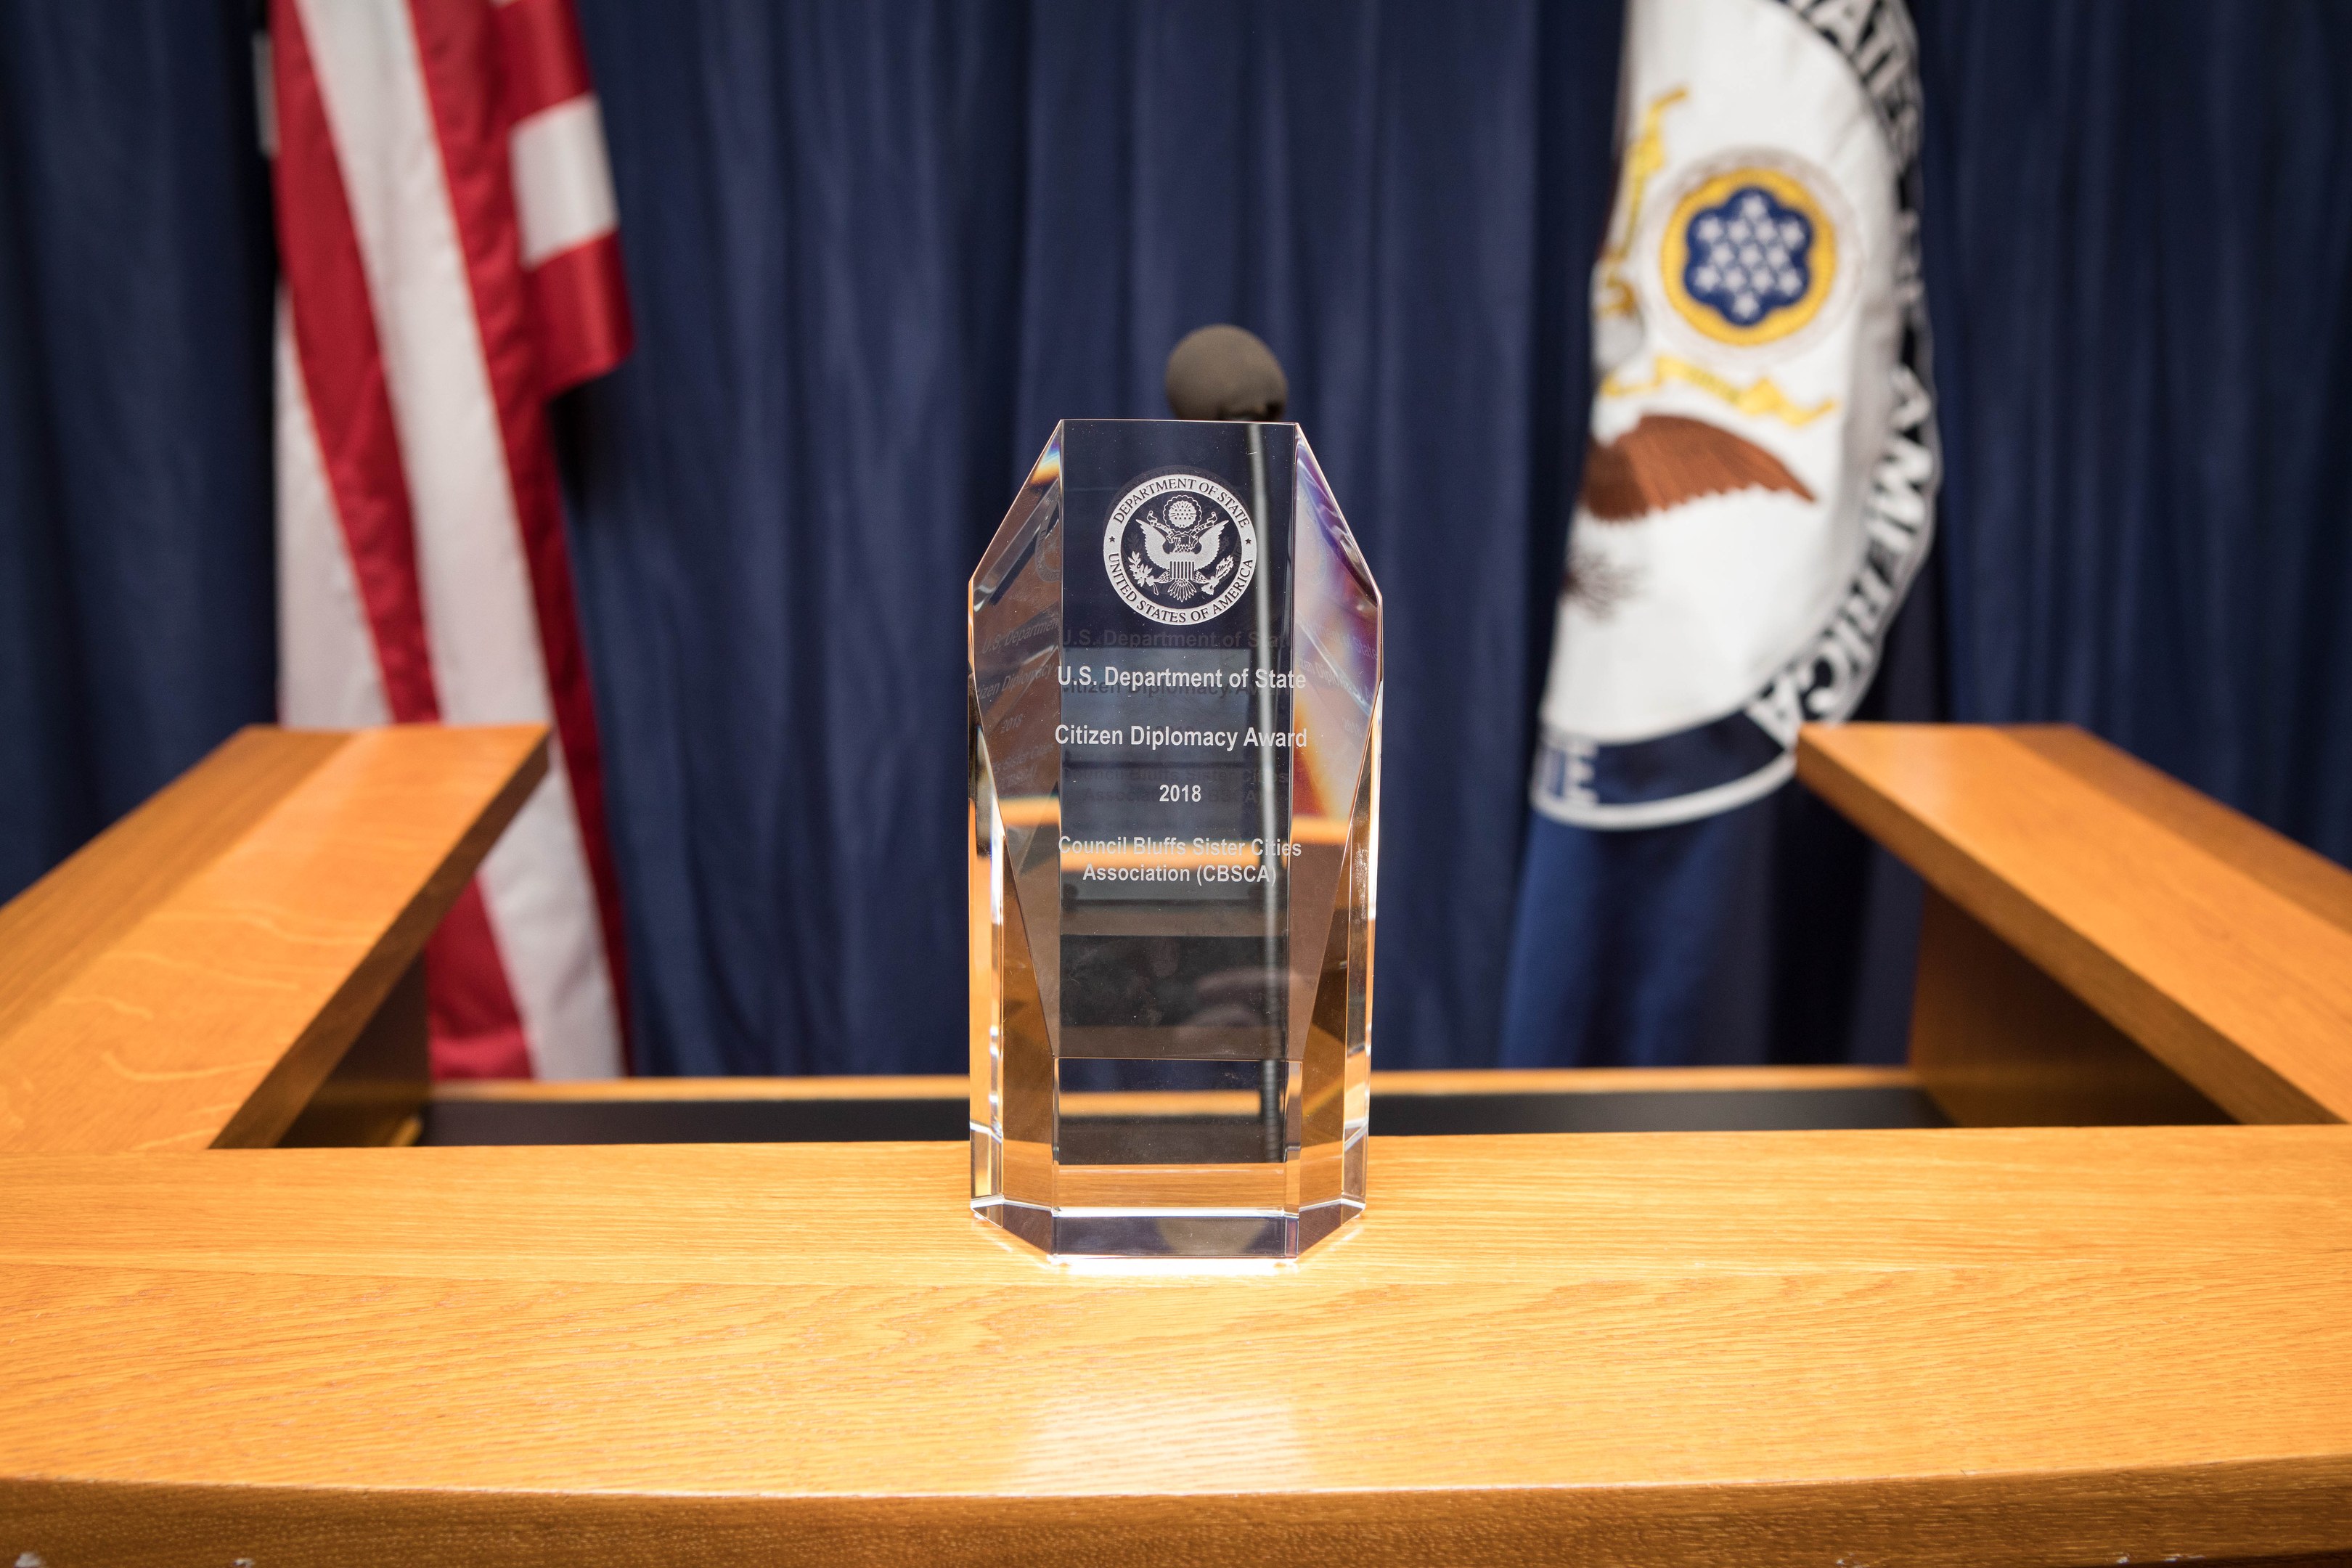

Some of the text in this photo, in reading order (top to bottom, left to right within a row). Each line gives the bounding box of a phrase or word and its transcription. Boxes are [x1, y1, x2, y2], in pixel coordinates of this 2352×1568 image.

[1113, 478, 1250, 528] DEPARTMENT OF STATE
[1108, 553, 1253, 623] UNITED STATES OF AMERICA
[1004, 618, 1060, 646] Departmen
[1058, 666, 1097, 685] U.S.
[1105, 666, 1222, 691] Department
[1229, 668, 1249, 687] of
[1255, 669, 1307, 689] State
[1055, 724, 1307, 752] Citizen Diplomacy Award
[1159, 784, 1201, 802] 2018
[1058, 836, 1302, 857] Council Bluffs Sister Cities
[1082, 863, 1276, 886] Association (CBSCA)
